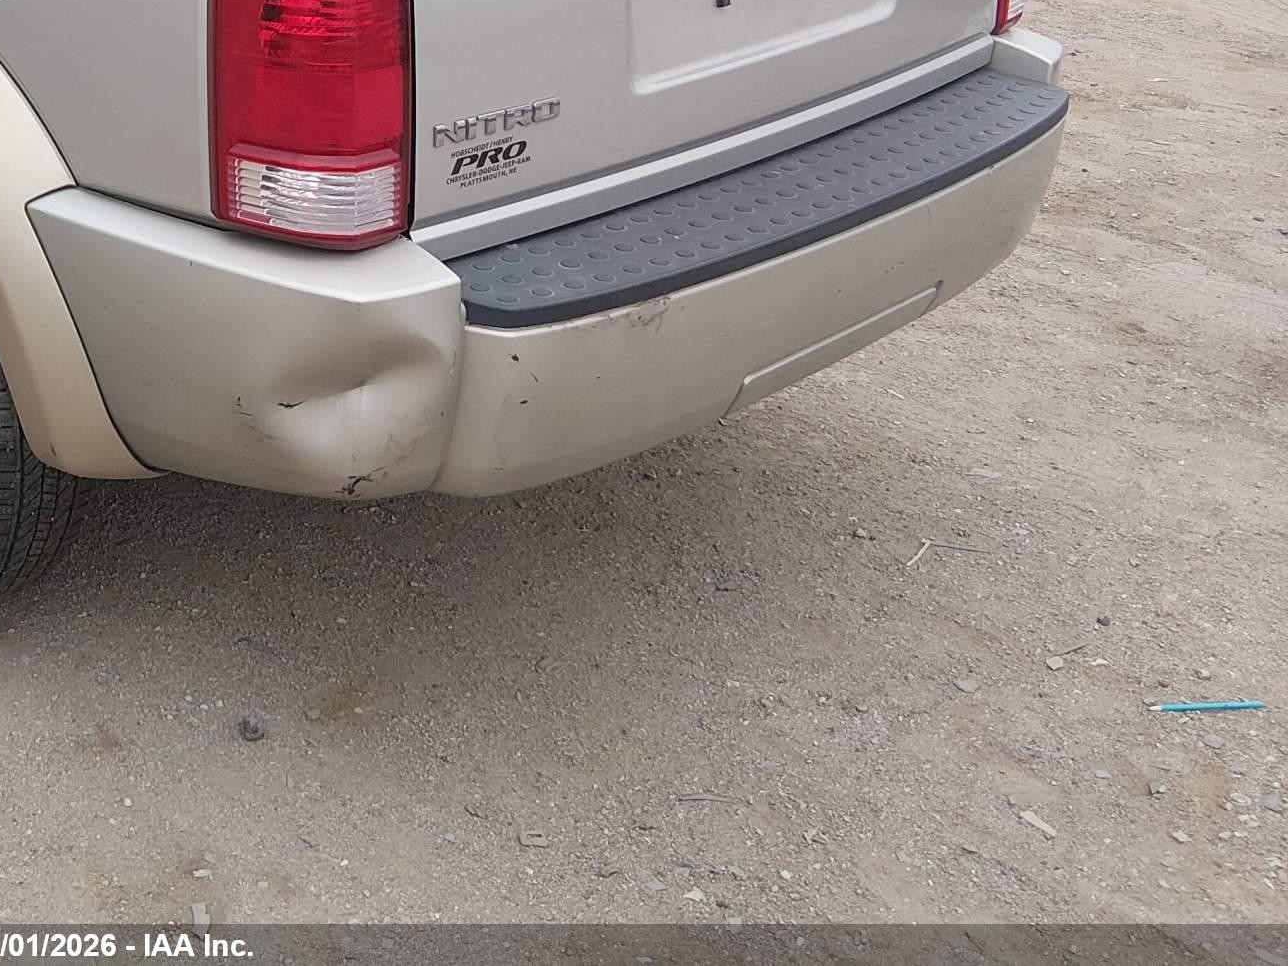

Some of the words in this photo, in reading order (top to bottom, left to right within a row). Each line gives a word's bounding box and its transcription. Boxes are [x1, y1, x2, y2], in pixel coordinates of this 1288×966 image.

[433, 96, 561, 149] NITRO
[450, 140, 528, 176] PRO
[508, 166, 518, 176] NE
